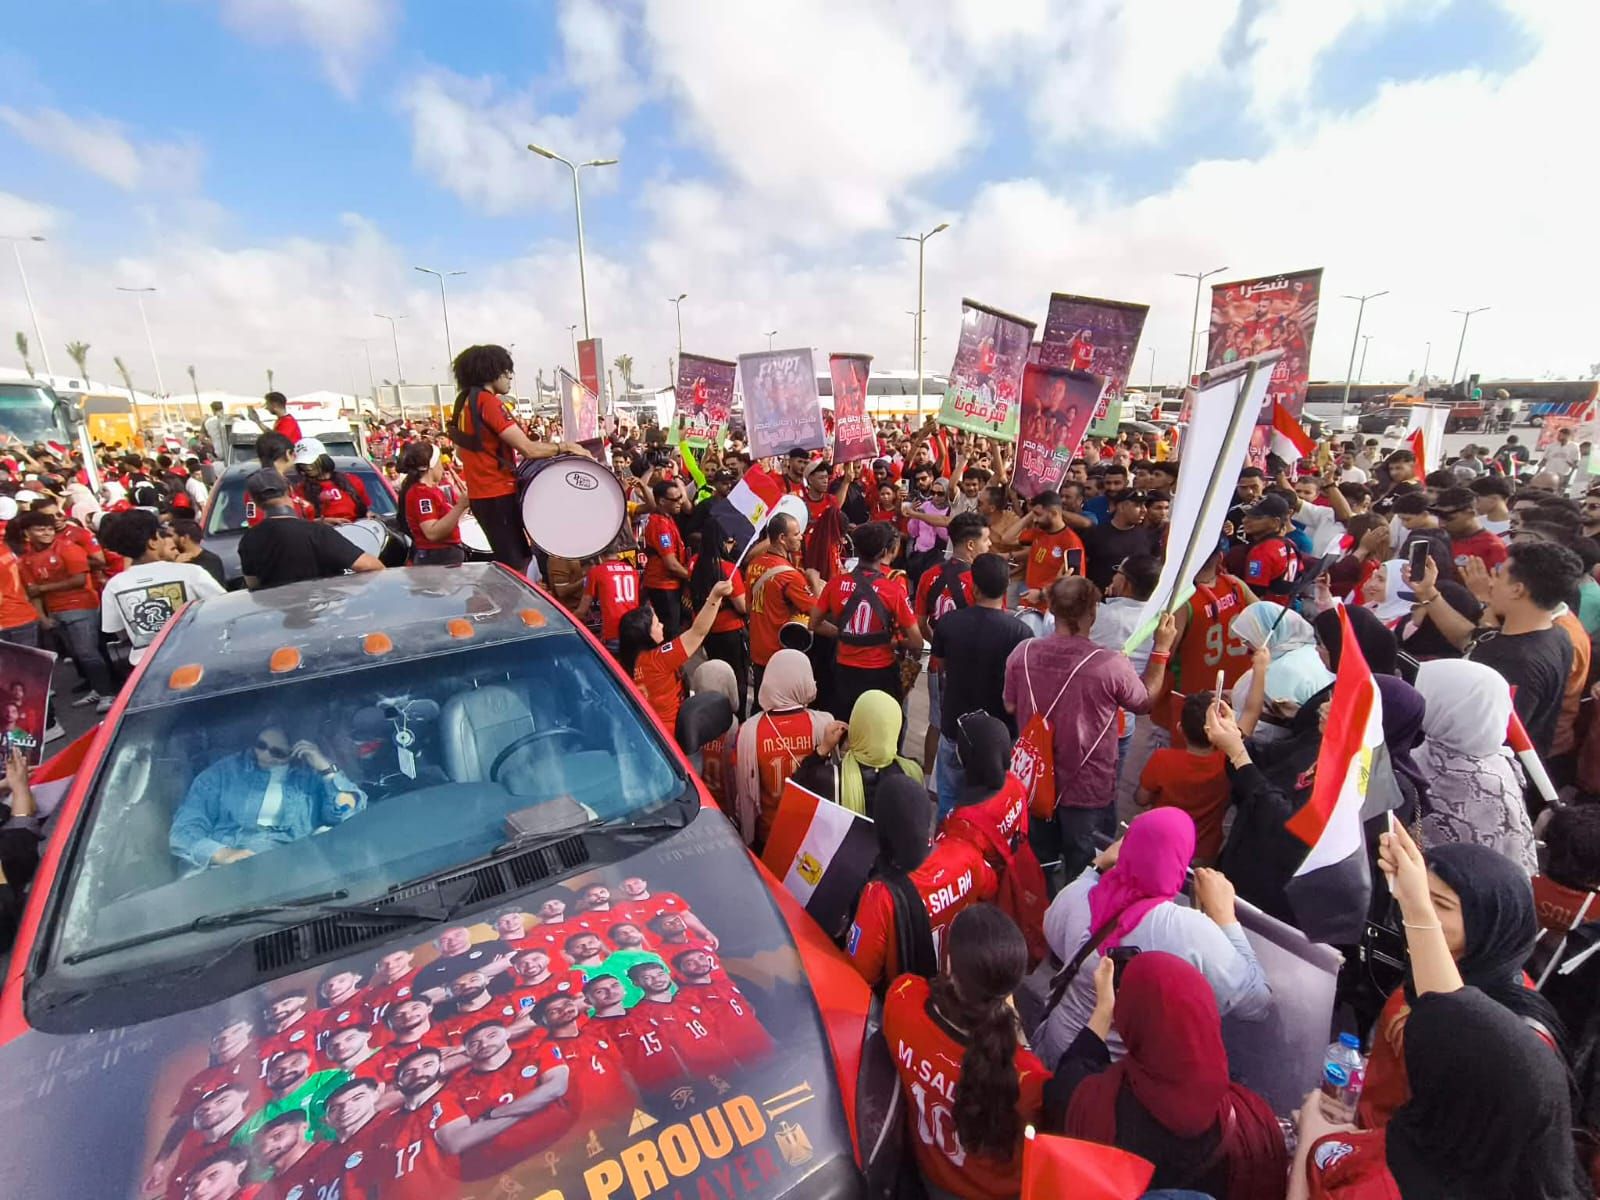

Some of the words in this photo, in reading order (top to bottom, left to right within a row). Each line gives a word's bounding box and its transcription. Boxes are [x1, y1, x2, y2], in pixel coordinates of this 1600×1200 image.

[1240, 275, 1289, 298] شكرا
[613, 574, 635, 604] 10
[763, 736, 812, 753] M.SALAH
[922, 869, 972, 917] .SALAH
[730, 999, 743, 1016] 6
[639, 1031, 663, 1056] 15
[686, 1019, 708, 1040] 18
[591, 1055, 606, 1074] 4
[899, 1039, 956, 1103] M.SAL
[911, 1081, 967, 1167] 10
[395, 1140, 422, 1178] 17
[583, 1094, 768, 1200] PROUD
[674, 1147, 783, 1200] AYER
